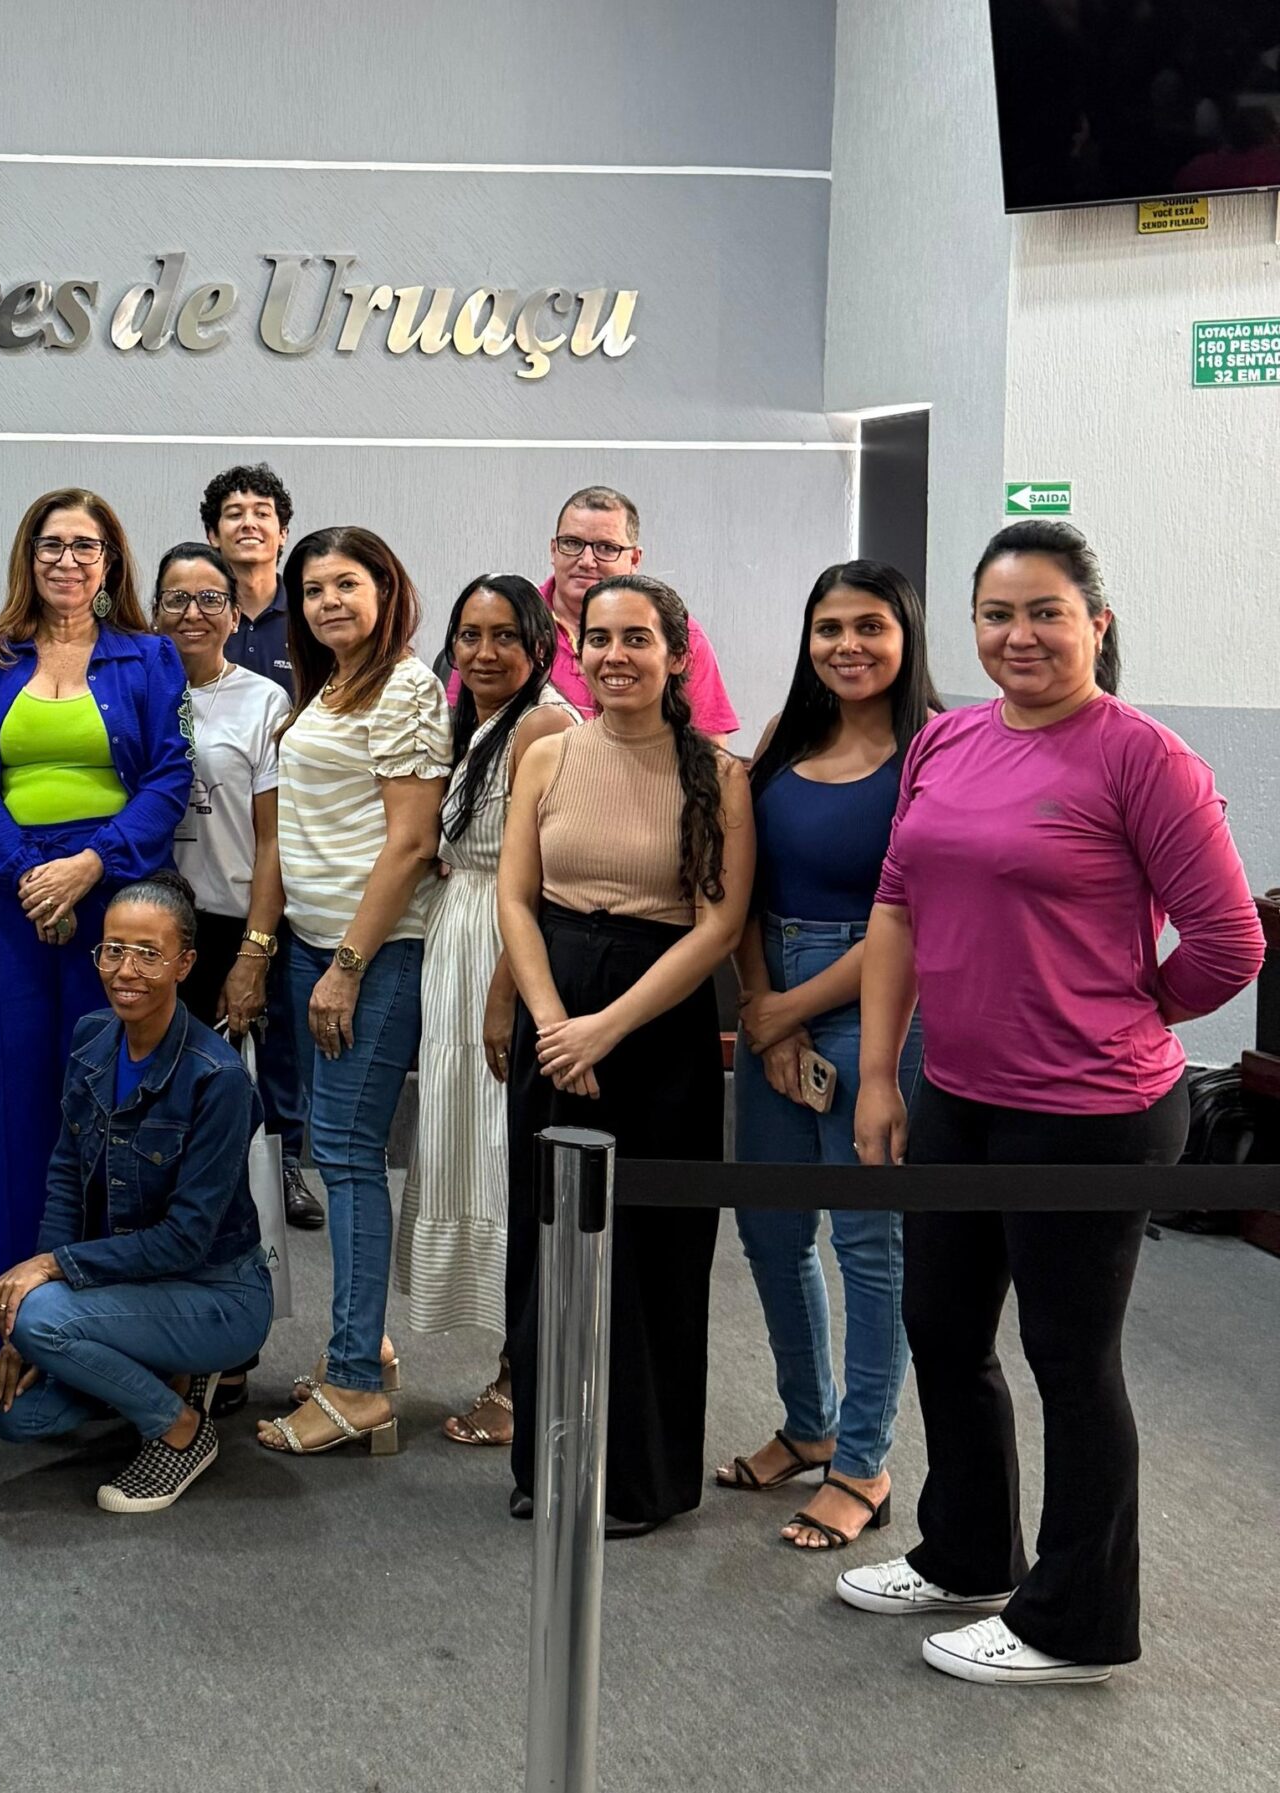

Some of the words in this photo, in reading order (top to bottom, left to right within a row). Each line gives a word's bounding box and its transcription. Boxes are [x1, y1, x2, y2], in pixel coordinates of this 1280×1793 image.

[1152, 208, 1173, 218] VOCÊ
[1175, 206, 1195, 216] ESTÁ
[1142, 220, 1168, 230] SENDO
[1170, 217, 1206, 228] FILMADO
[109, 251, 235, 351] de
[260, 252, 639, 379] Uruaçu
[1198, 325, 1251, 339] LOTAÇÃO
[1198, 341, 1226, 354] 150
[1198, 355, 1223, 368] 118
[1214, 370, 1234, 382] 32
[1238, 368, 1261, 381] EM
[1028, 493, 1068, 503] SAÍDA
